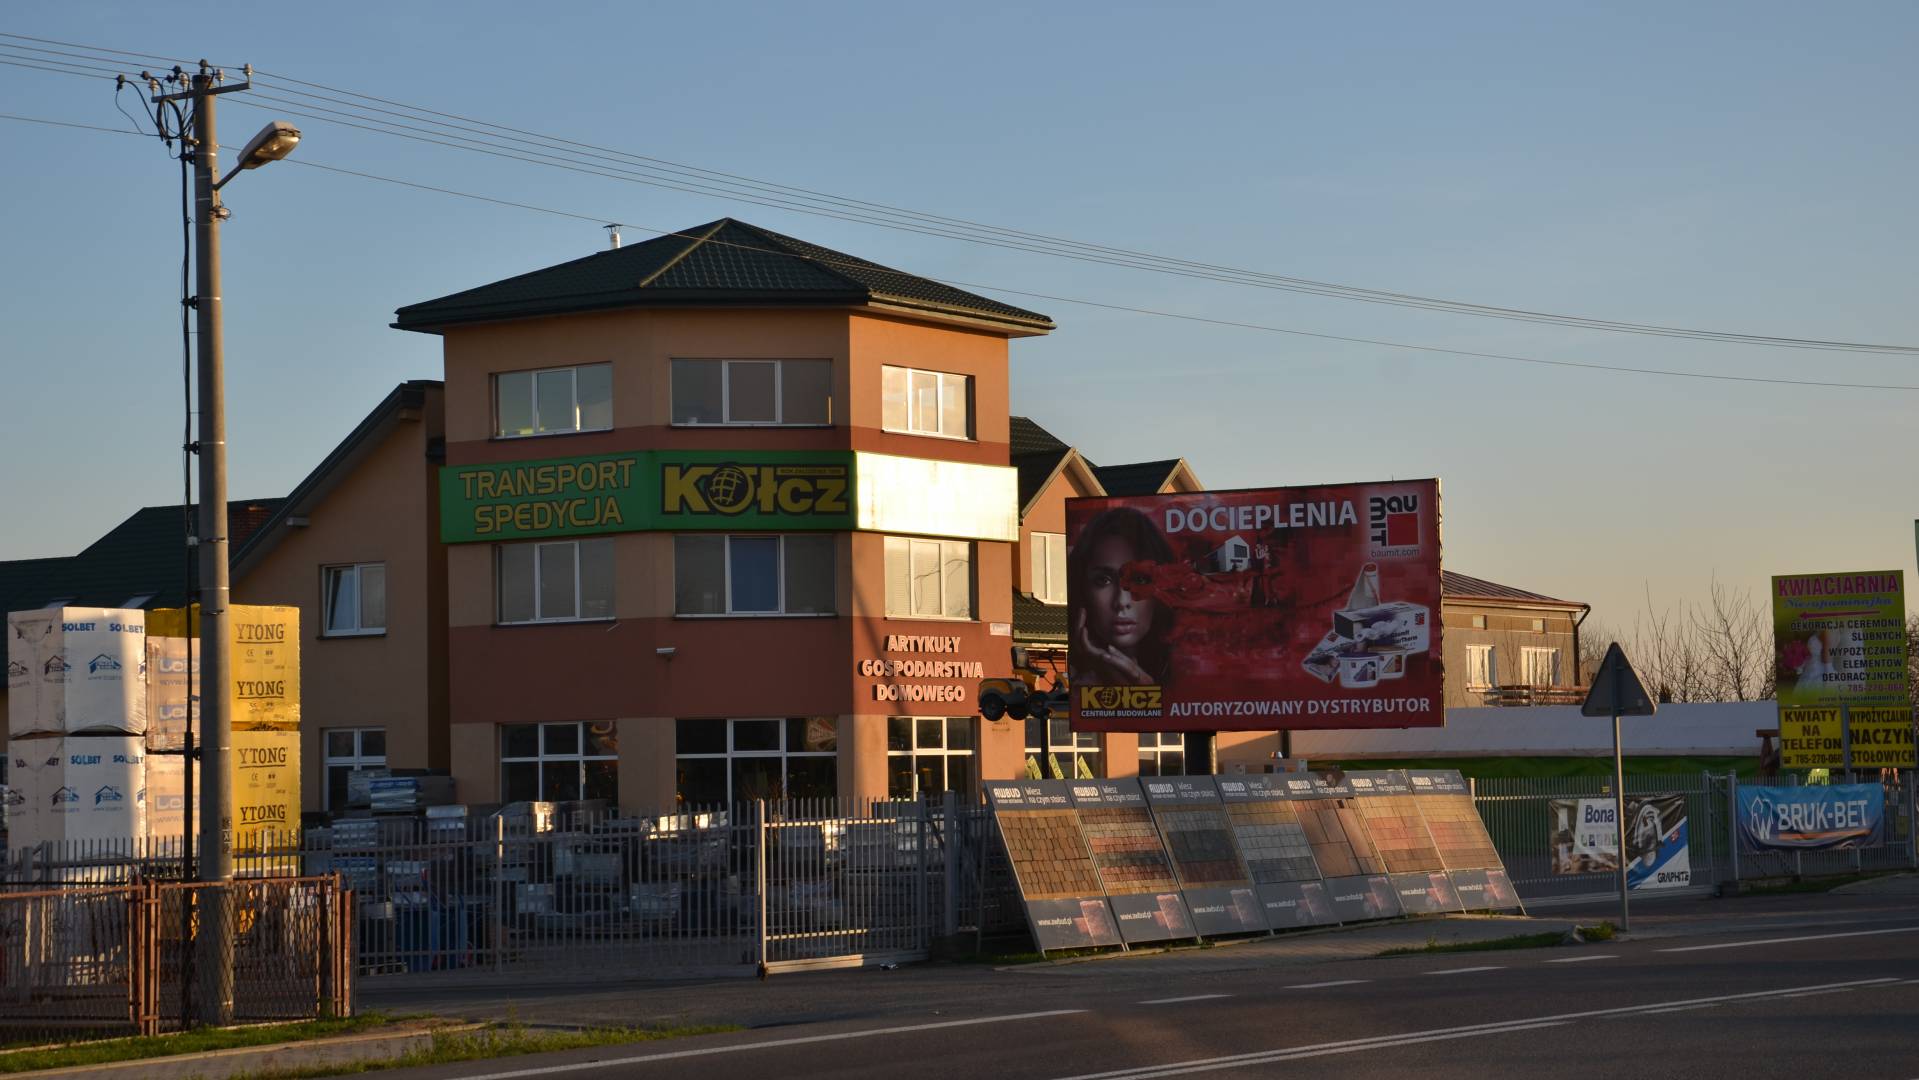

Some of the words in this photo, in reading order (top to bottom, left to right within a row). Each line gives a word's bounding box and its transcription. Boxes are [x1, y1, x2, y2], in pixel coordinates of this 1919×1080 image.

[459, 458, 636, 499] TRANSPORT
[474, 496, 623, 535] SPEDYCJA
[1165, 500, 1359, 533] DOCIEPLENIA
[1371, 548, 1420, 558] baumit.com
[1778, 575, 1899, 597] KWIACIARNIA
[62, 622, 96, 632] SOLBET
[109, 623, 144, 634] SOLBET
[236, 622, 286, 641] YTONG
[1847, 618, 1901, 629] CEREMONII
[887, 634, 961, 654] ARTYKUŁY
[859, 659, 983, 680] GOSPODARSTWA
[1822, 672, 1903, 682] DEKORACYJNYCH
[237, 680, 285, 696] YTONG
[875, 682, 965, 703] DOMOWEGO
[1170, 700, 1303, 717] AUTORYZOWANY
[1308, 698, 1430, 714] DYSTRYBUTOR
[1784, 710, 1836, 722] KWIATY
[1802, 725, 1820, 736] NA
[1782, 738, 1842, 750] TELEFON
[70, 755, 101, 765] SOLBET
[238, 747, 287, 764] YTONG
[1851, 750, 1915, 762] STOŁOWYCH
[240, 804, 287, 821] YTONG
[1585, 805, 1614, 824] Bona
[1777, 800, 1868, 831] BRUK-BET
